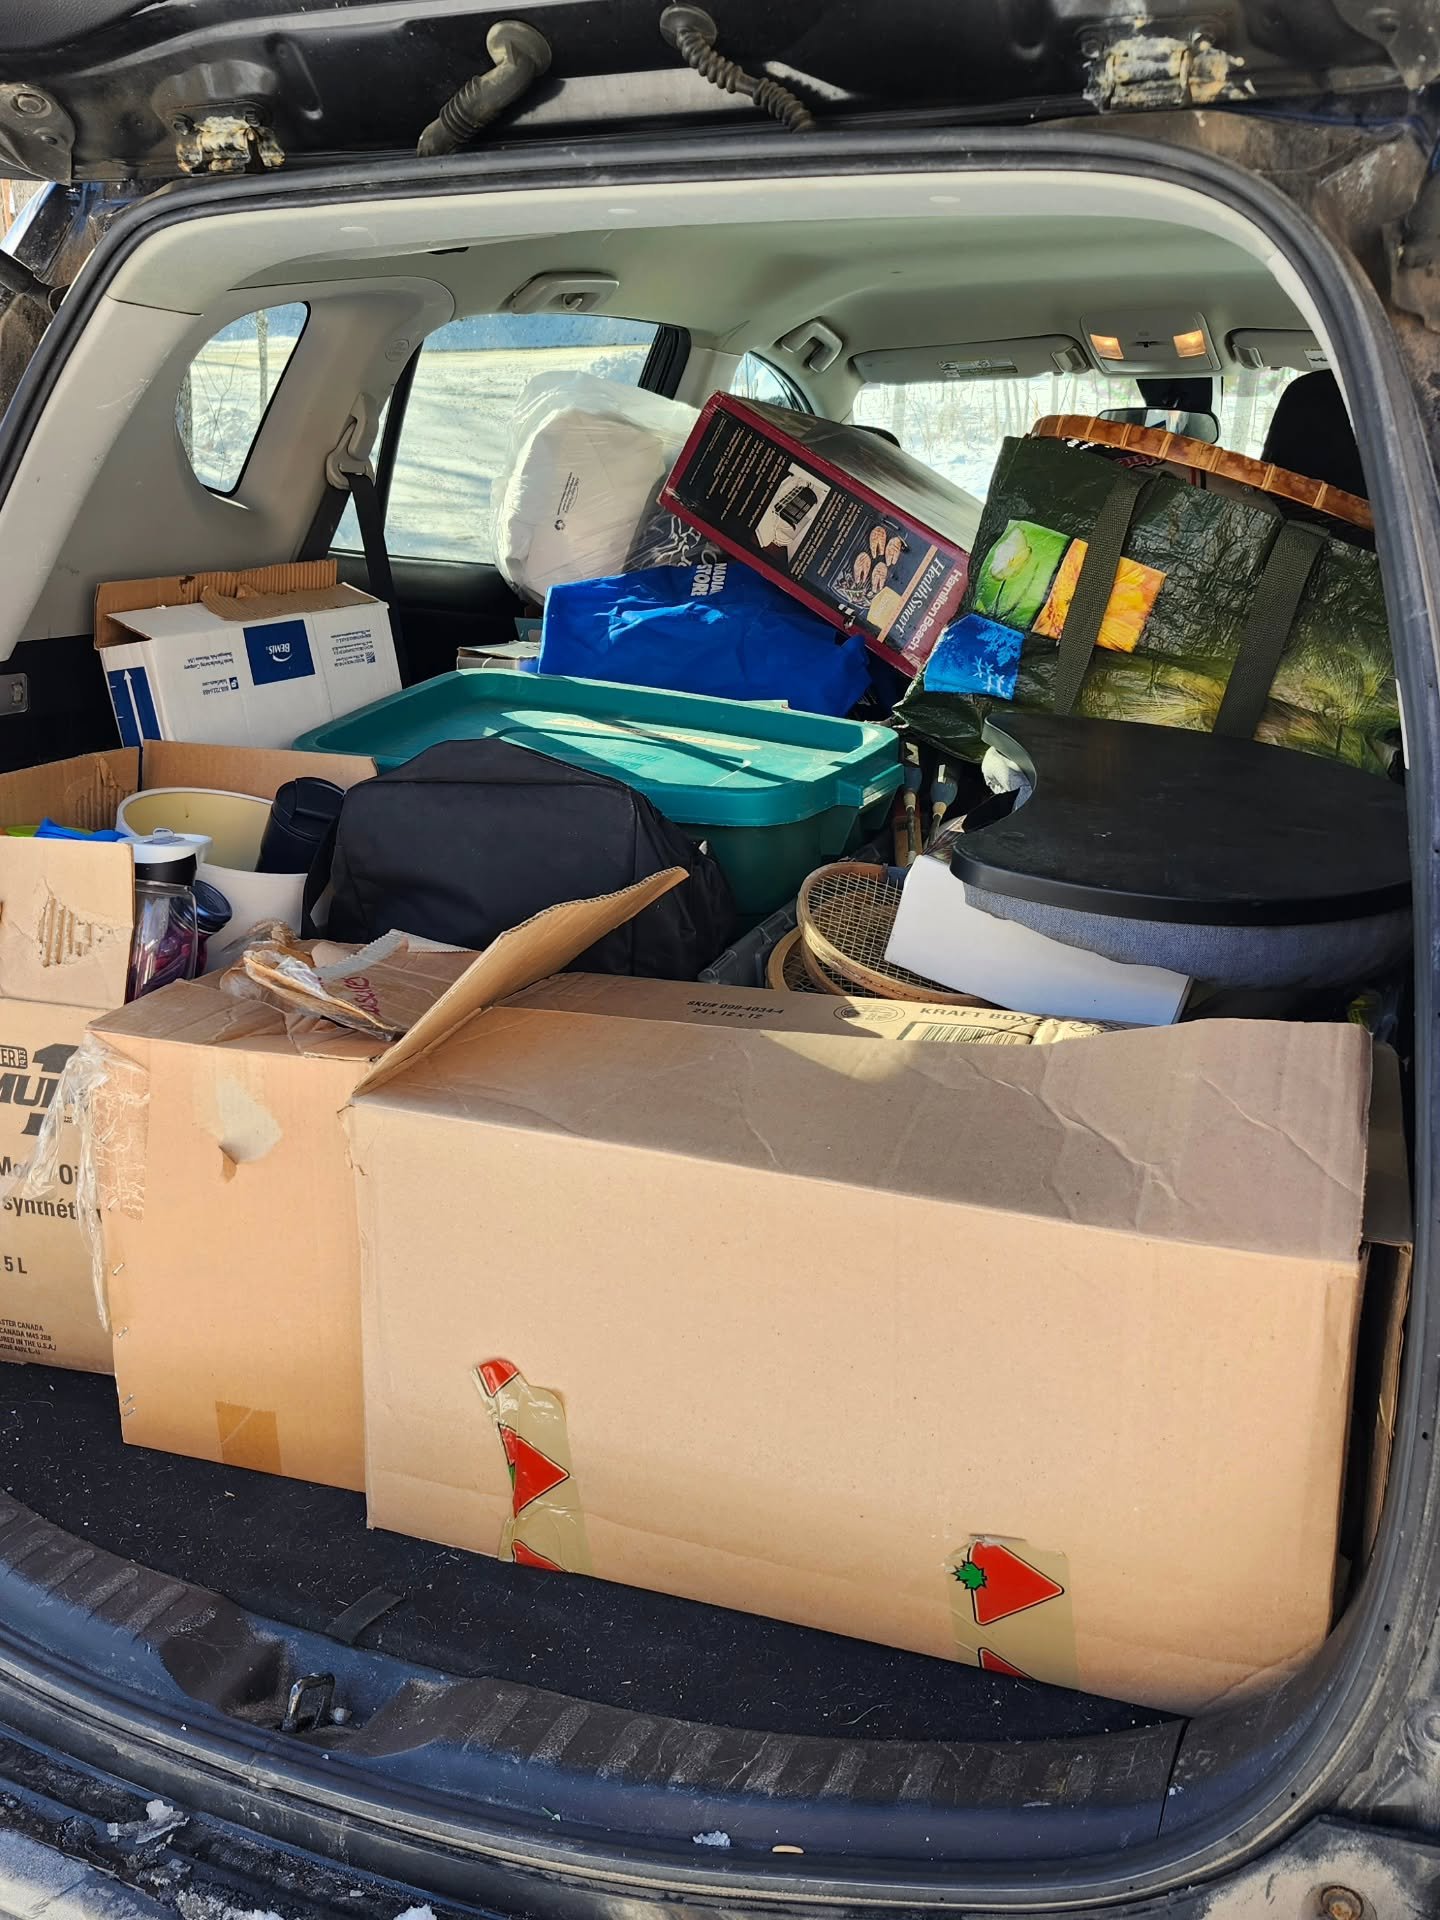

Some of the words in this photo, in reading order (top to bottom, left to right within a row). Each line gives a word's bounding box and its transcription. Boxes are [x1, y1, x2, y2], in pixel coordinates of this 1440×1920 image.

[690, 563, 712, 597] STORE
[893, 557, 947, 636] HealthSmart
[928, 568, 963, 619] Hamilton
[907, 615, 935, 652] Beach
[268, 642, 291, 655] BEMIS
[920, 1007, 984, 1018] KRAFT
[989, 1012, 1031, 1024] BOX
[0, 1049, 16, 1066] ER
[18, 1321, 44, 1332] CANADA
